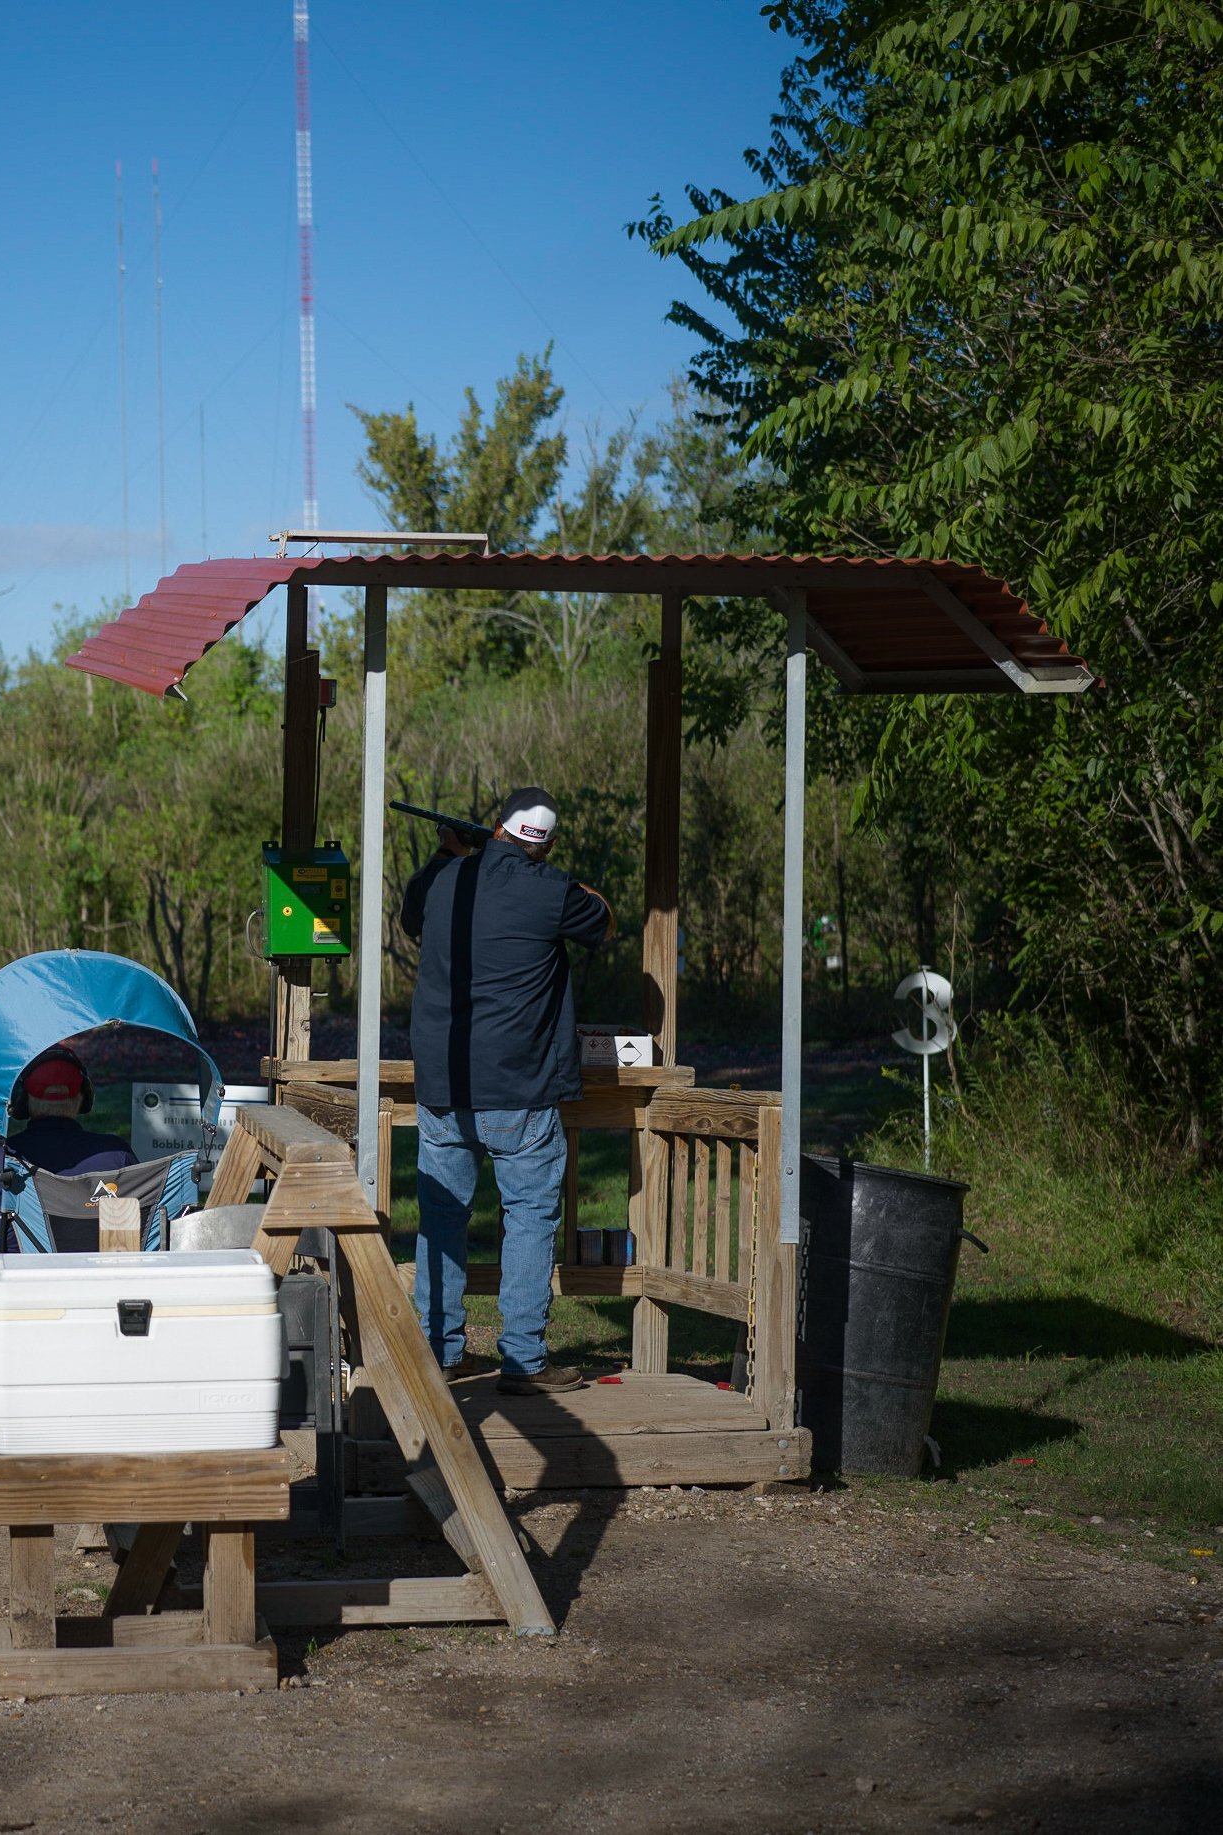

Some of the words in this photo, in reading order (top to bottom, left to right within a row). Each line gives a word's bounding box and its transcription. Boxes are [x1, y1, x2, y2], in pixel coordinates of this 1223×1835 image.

[891, 971, 957, 1054] 3
[164, 1117, 189, 1126] STATION
[191, 1118, 226, 1127] SPOED
[153, 1139, 184, 1149] Bobbi
[187, 1140, 195, 1149] &
[198, 1140, 226, 1151] Jona
